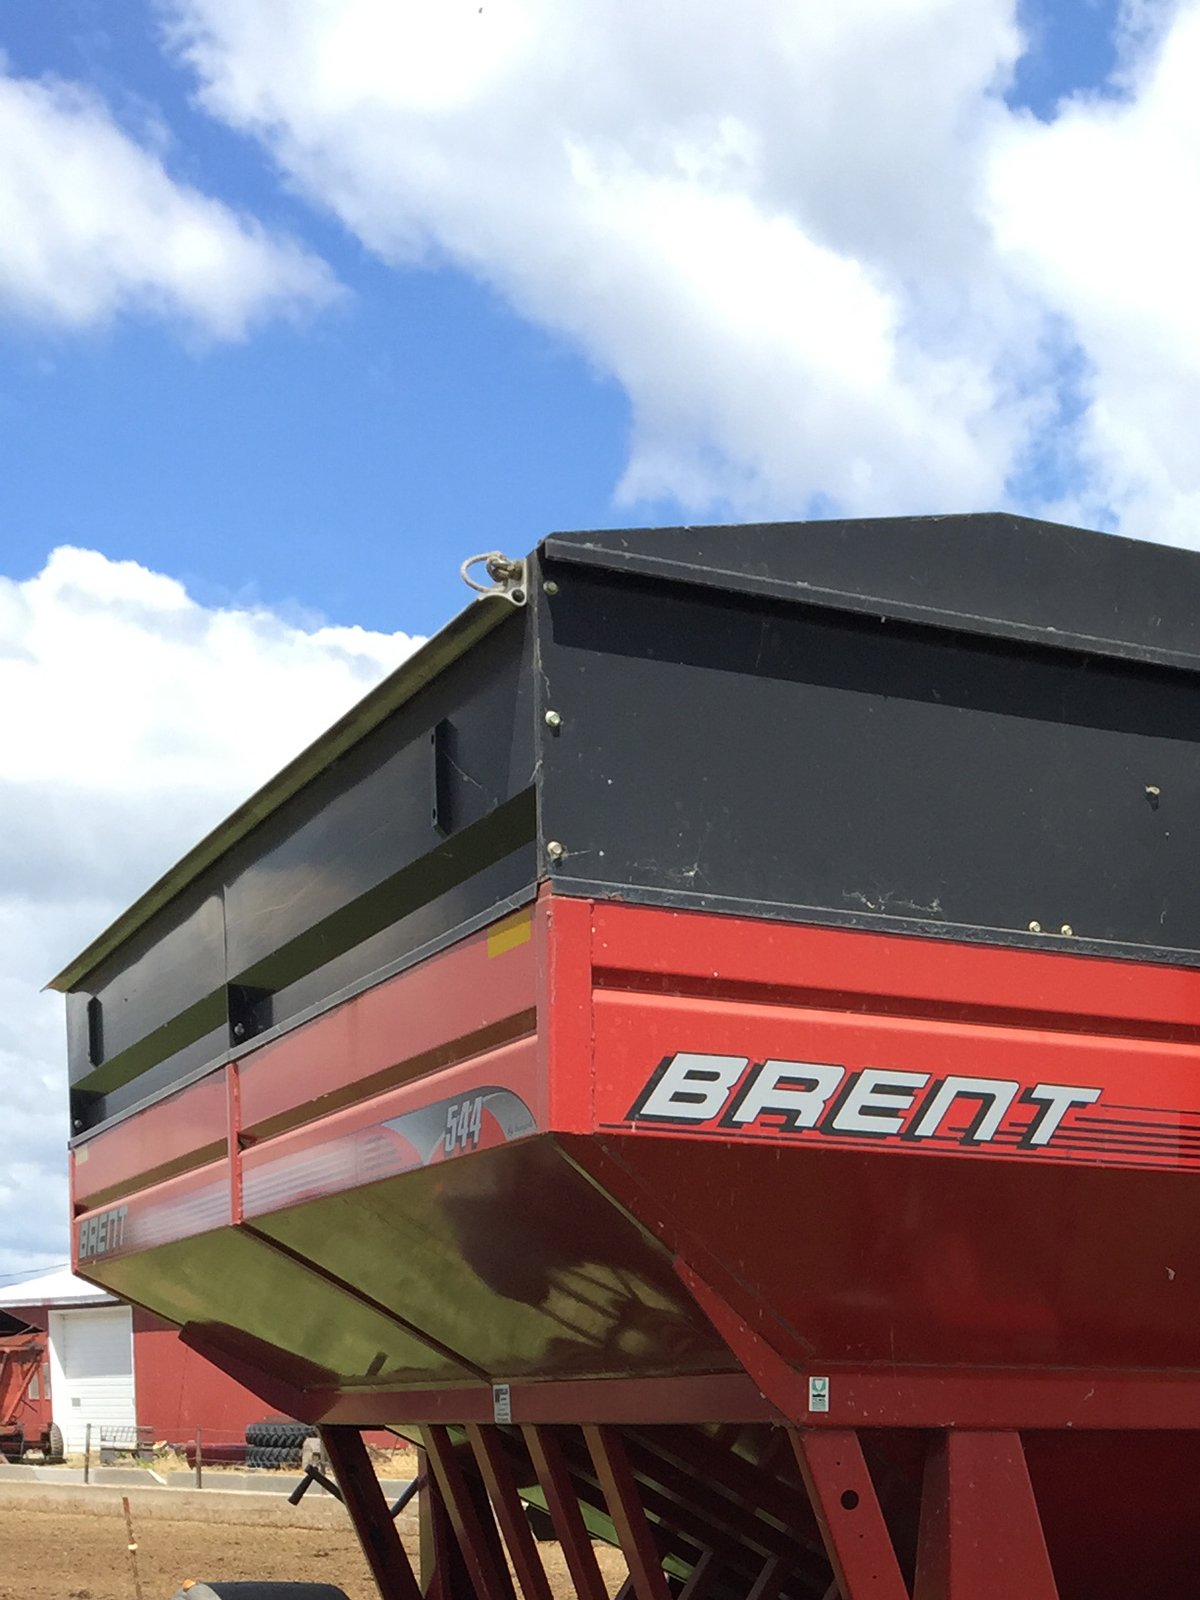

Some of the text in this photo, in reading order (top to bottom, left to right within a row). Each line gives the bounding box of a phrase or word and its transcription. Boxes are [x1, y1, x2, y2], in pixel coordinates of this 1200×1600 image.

[444, 1096, 483, 1152] 544
[628, 1051, 1102, 1149] BRENT
[79, 1205, 128, 1259] BRENT
